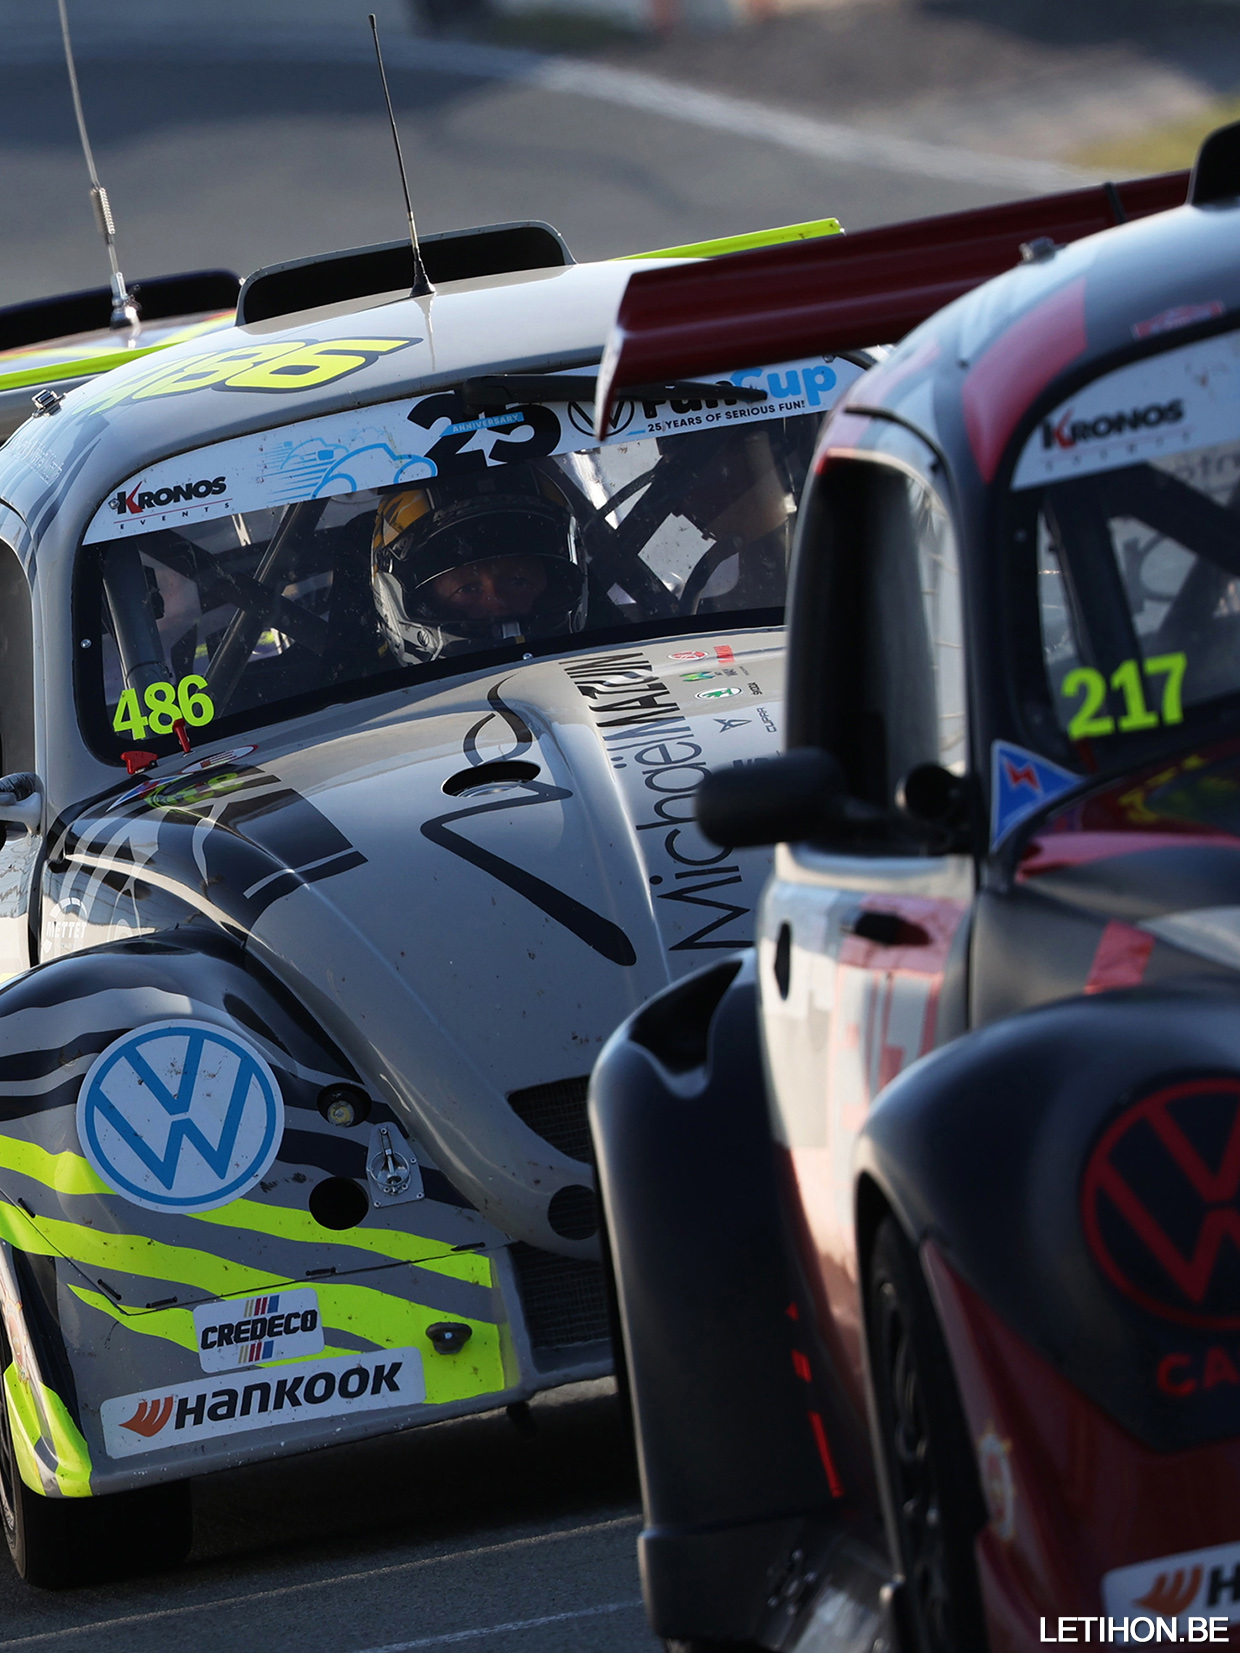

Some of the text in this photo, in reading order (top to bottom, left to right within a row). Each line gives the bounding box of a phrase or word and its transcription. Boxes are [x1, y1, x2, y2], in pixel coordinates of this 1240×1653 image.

[452, 414, 520, 433] ANNIVERSARY
[647, 399, 806, 433] 25 YEARS OF SERIOUS FUN!
[1041, 398, 1184, 450] KRONOS
[114, 476, 227, 515] KRONOS
[120, 502, 230, 530] EVENTS
[112, 674, 216, 741] 486
[1063, 652, 1188, 741] 217
[46, 920, 88, 938] METTET
[200, 1308, 318, 1350] CREDECO
